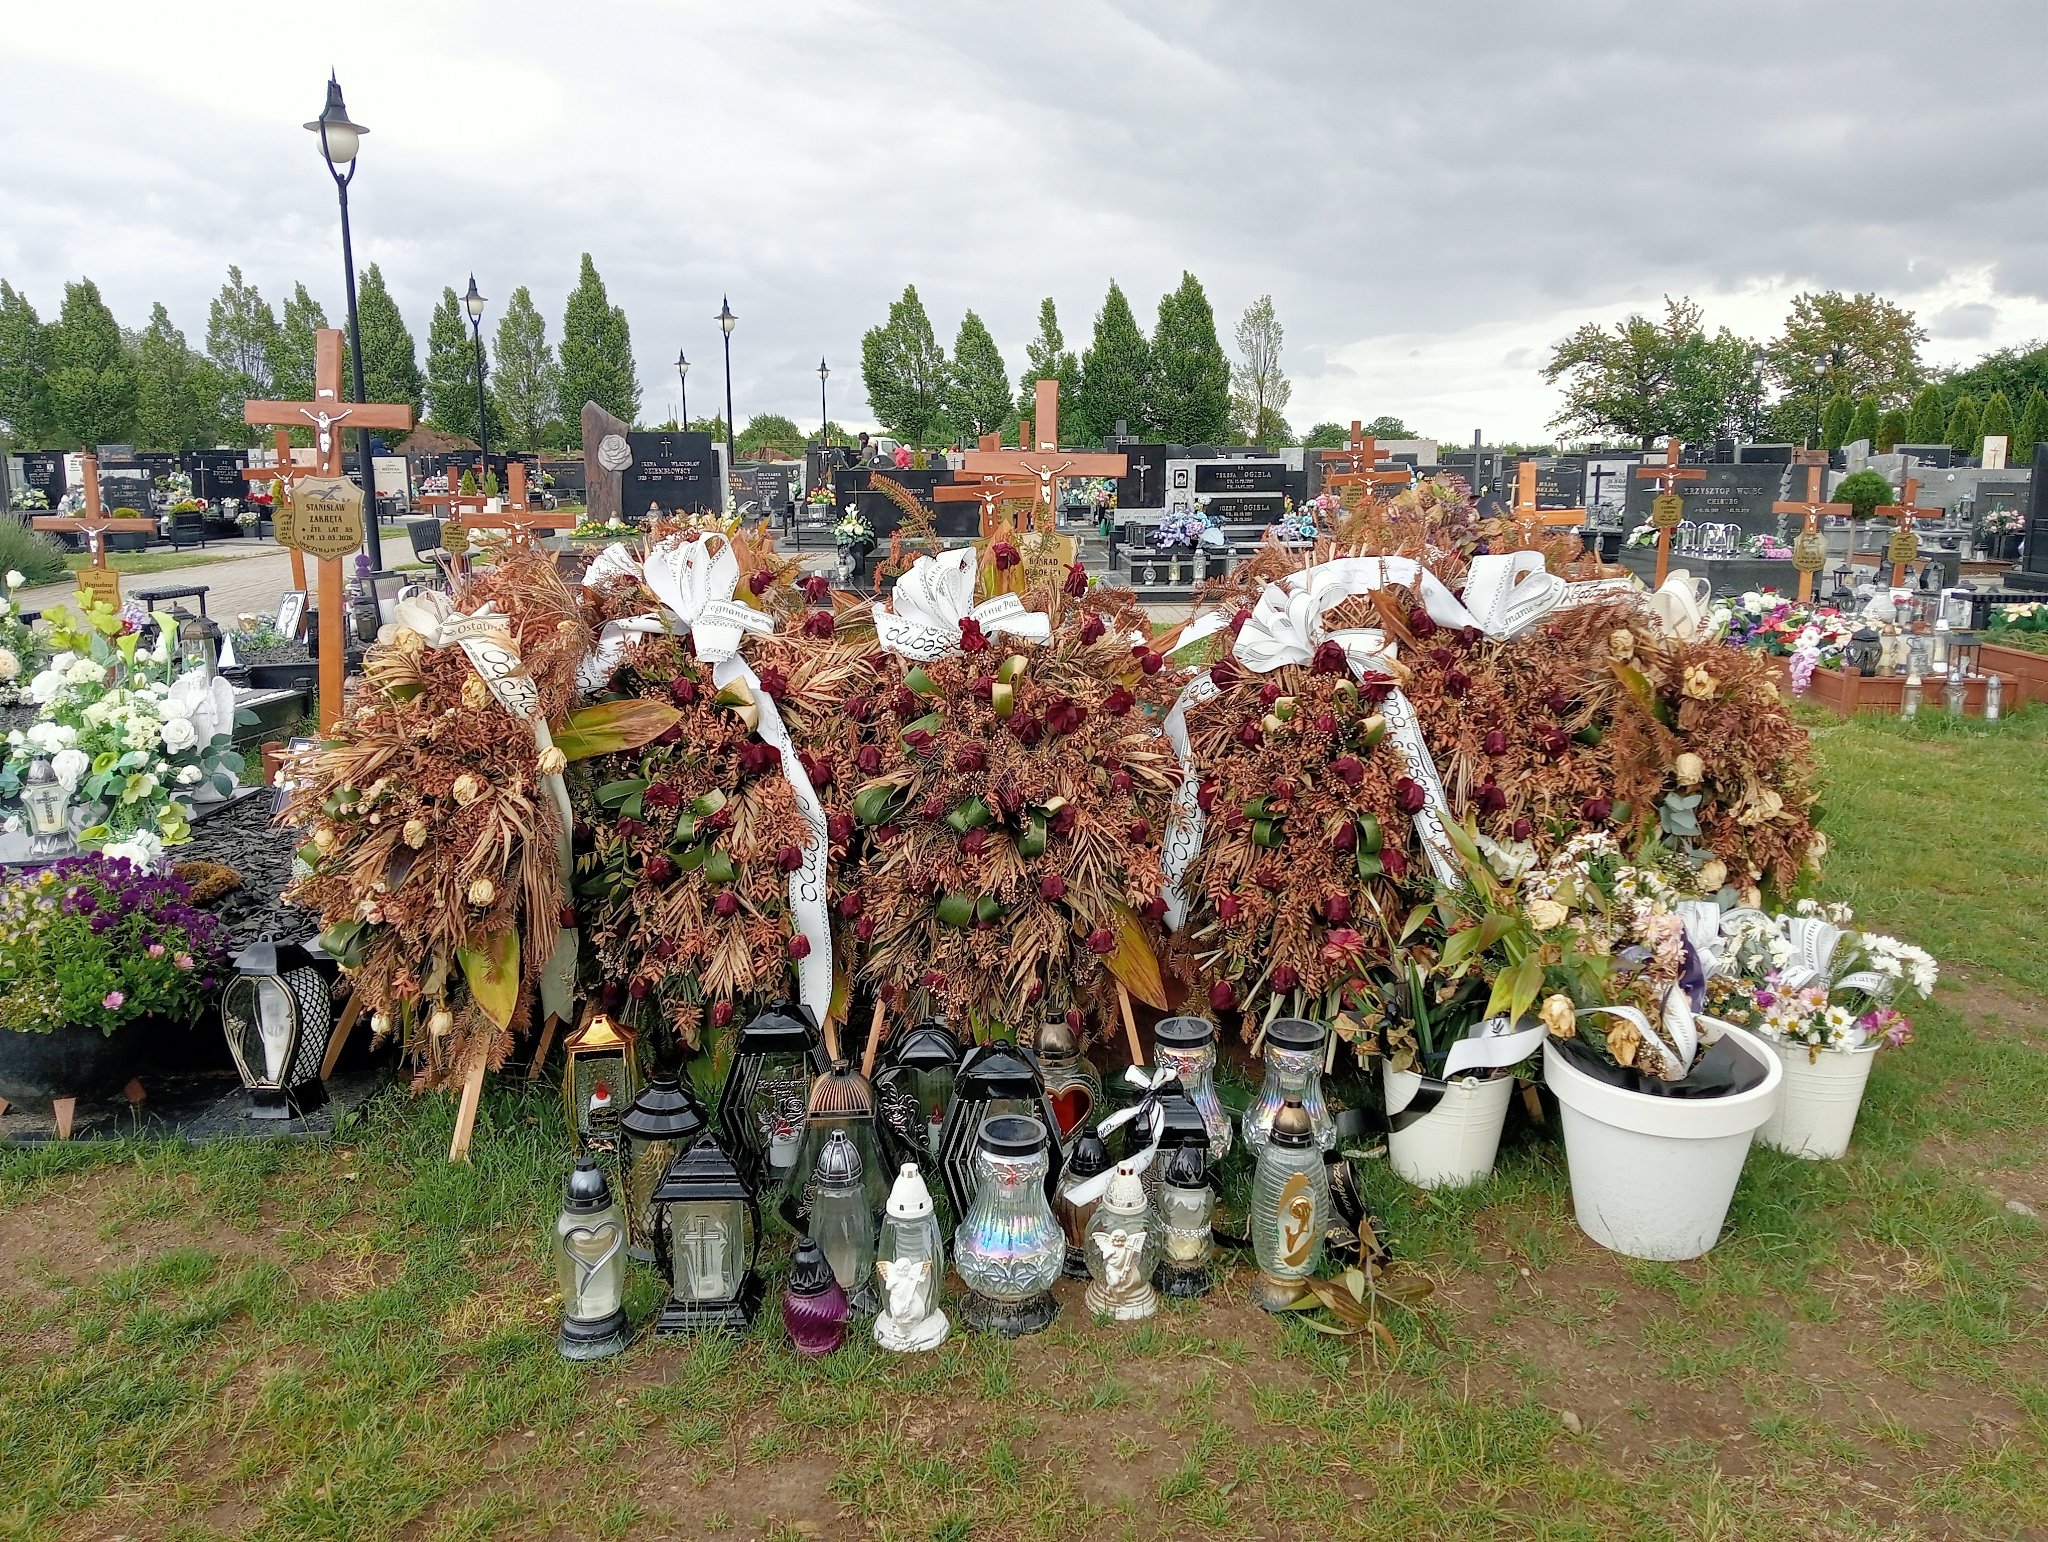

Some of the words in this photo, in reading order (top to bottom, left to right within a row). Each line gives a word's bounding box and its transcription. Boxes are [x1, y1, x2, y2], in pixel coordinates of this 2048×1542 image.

[305, 503, 346, 512] STANISŁAW
[309, 515, 343, 525] ZAKRĘTA
[310, 524, 322, 533] ŻYŁ
